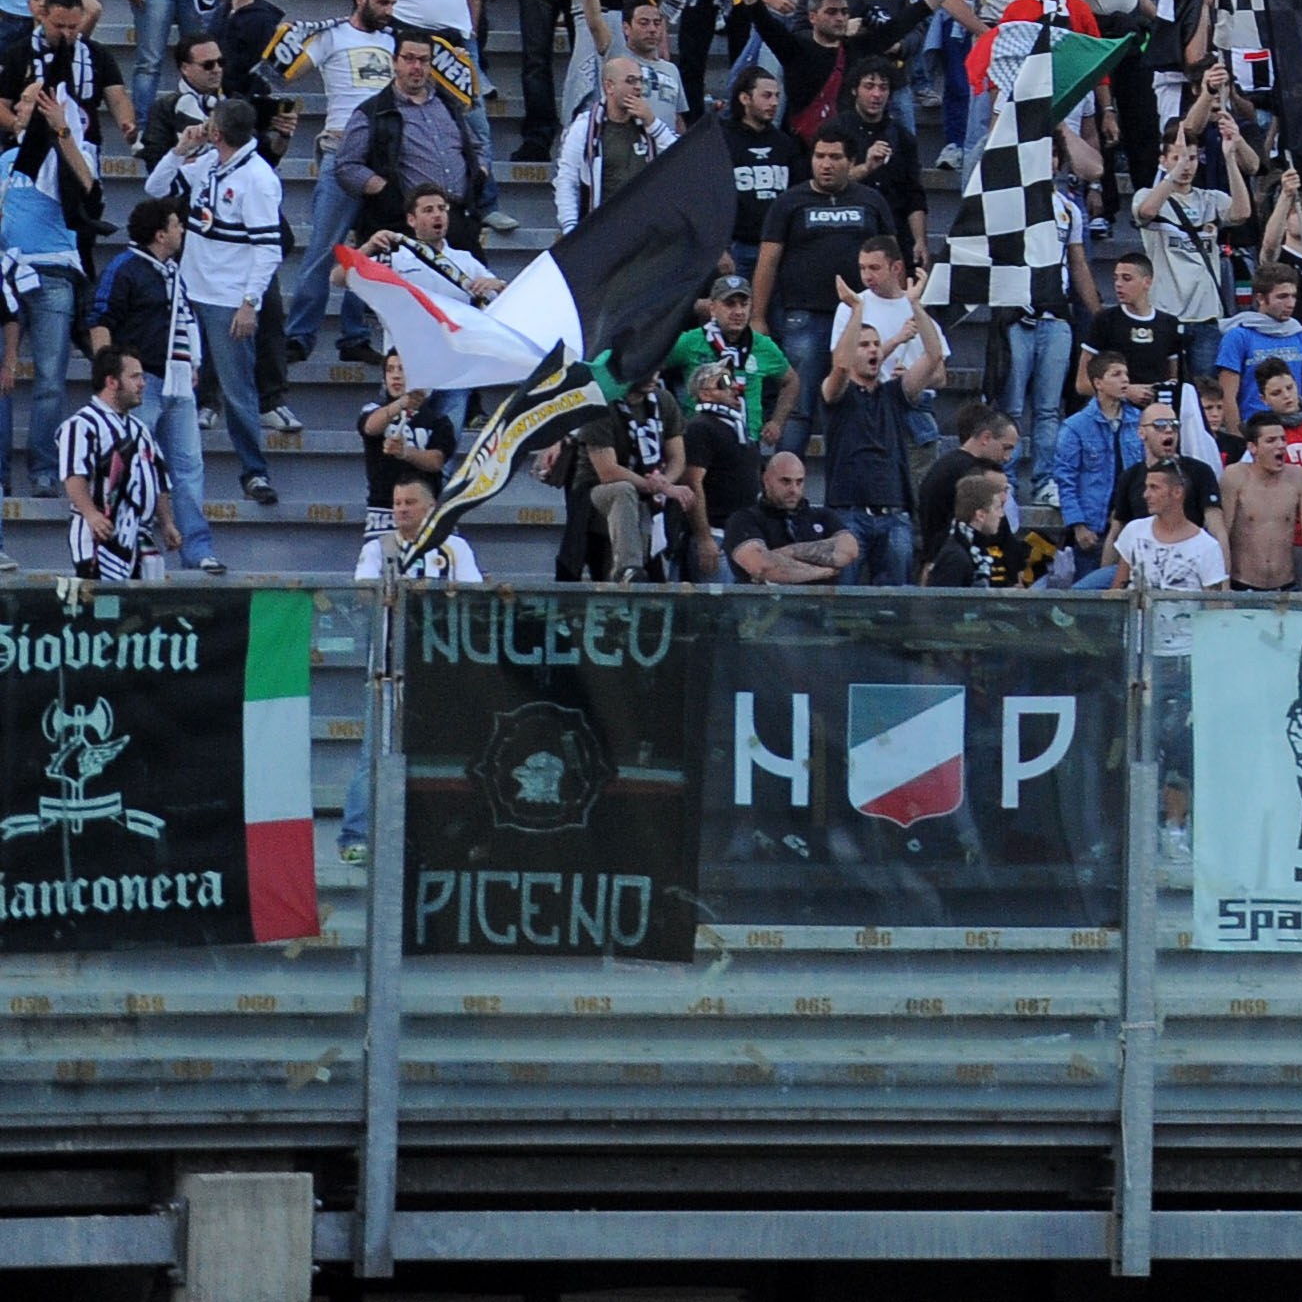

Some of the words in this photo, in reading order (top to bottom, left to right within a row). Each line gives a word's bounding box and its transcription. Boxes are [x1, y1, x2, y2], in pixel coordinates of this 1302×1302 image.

[734, 691, 811, 807] H
[1001, 695, 1077, 809] P
[416, 869, 654, 946] PICENO
